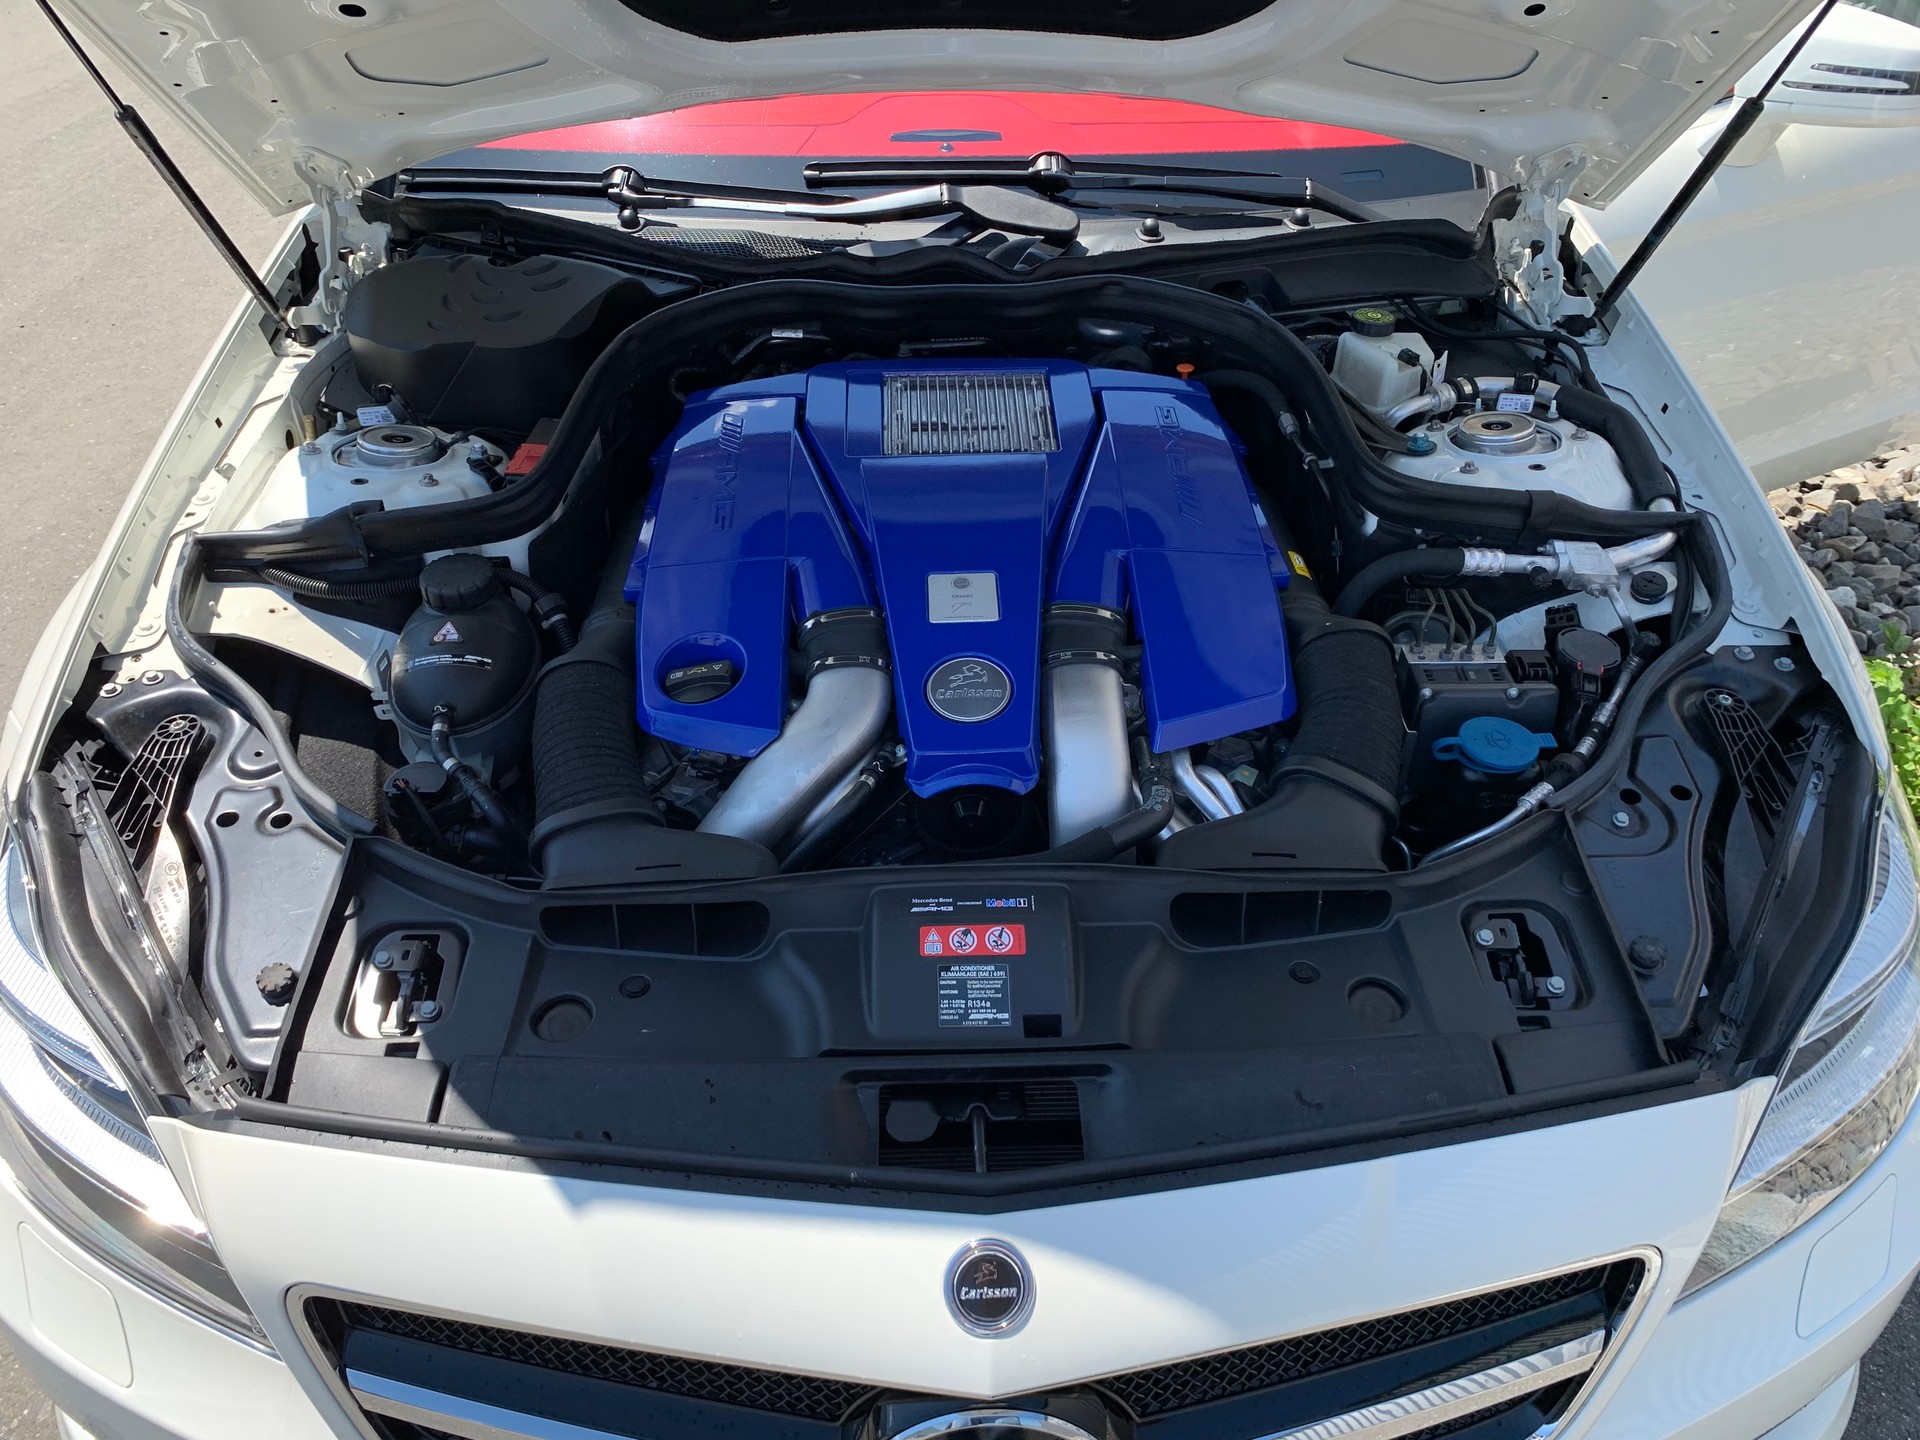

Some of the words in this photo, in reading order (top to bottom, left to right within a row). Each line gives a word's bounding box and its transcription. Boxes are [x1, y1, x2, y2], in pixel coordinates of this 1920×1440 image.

[936, 687, 1002, 700] Carlsson
[986, 898, 1016, 907] Mobil
[960, 1286, 1018, 1300] Carlsson
